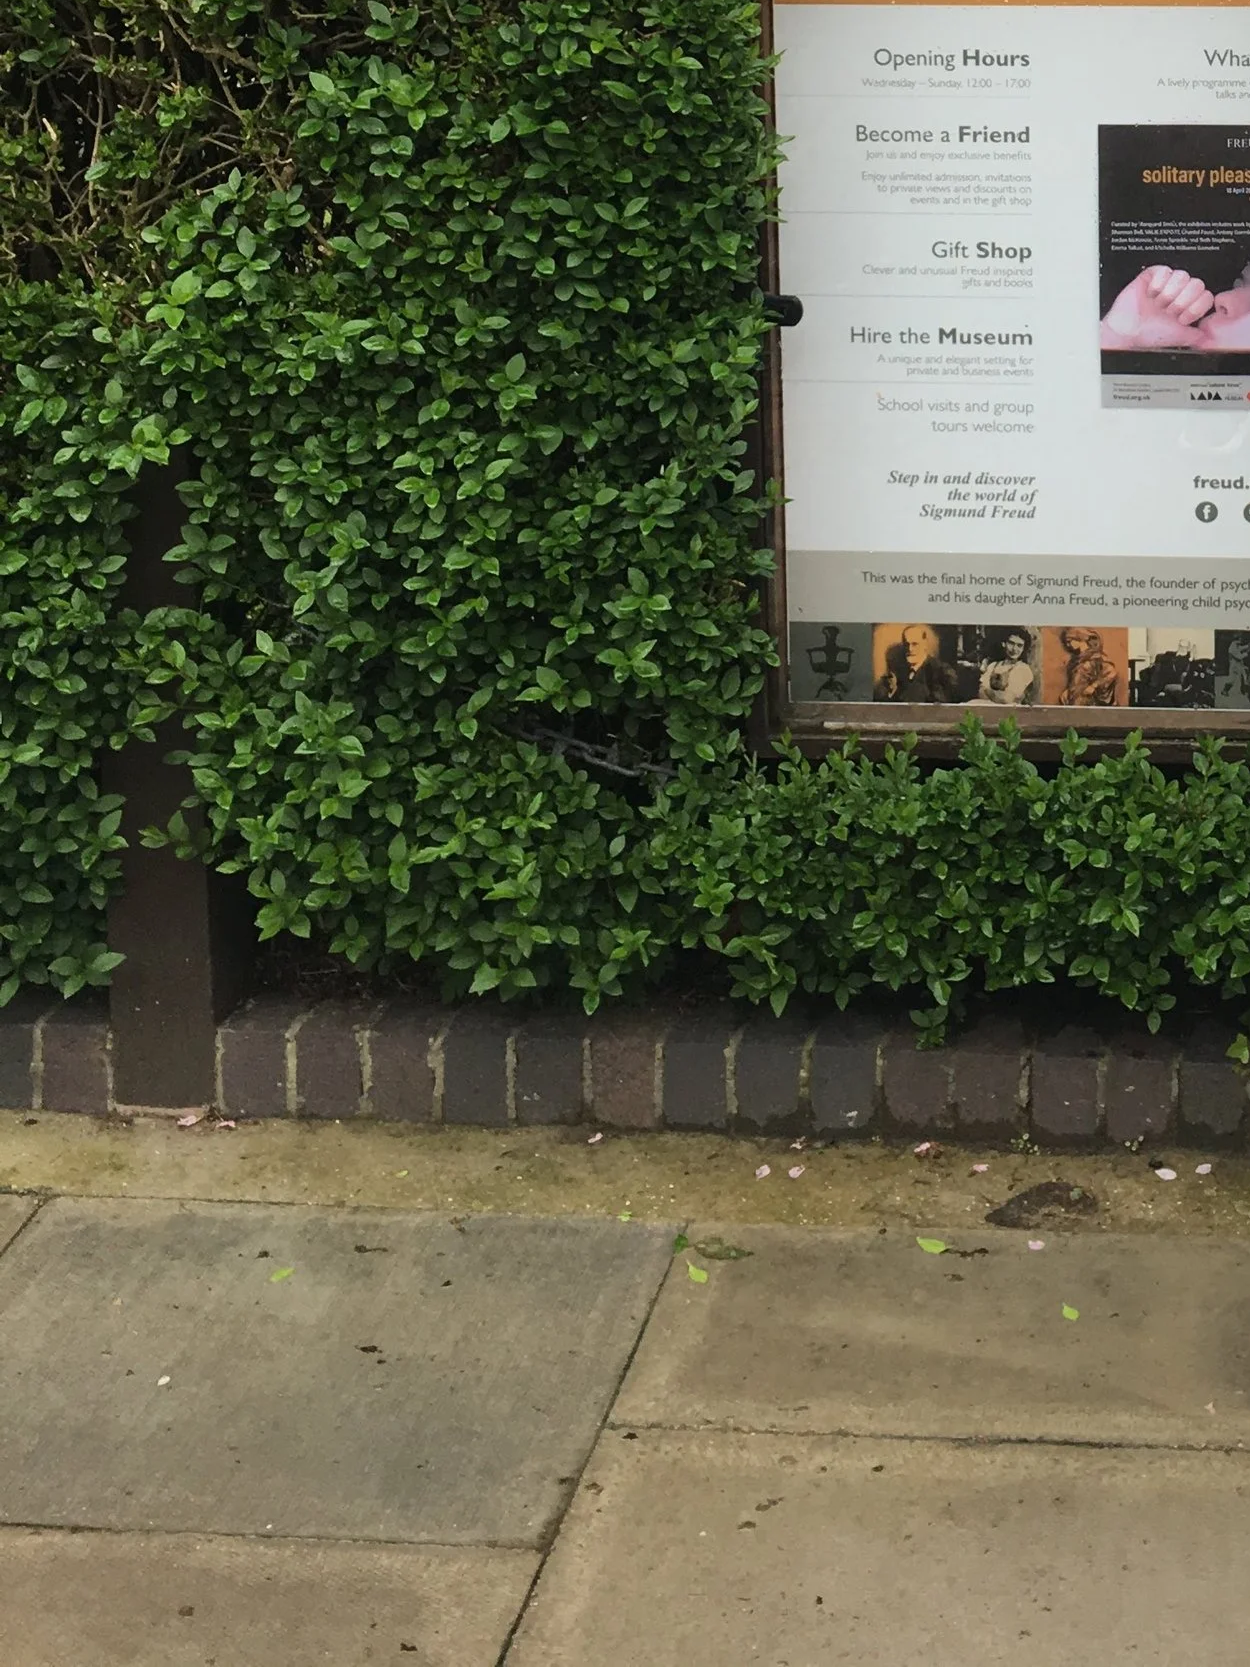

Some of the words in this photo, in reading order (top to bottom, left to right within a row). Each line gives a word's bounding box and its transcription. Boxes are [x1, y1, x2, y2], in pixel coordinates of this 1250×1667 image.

[874, 48, 954, 70] Opening
[962, 49, 1029, 66] Hours
[862, 78, 915, 90] Wednesday
[968, 79, 992, 87] 12:00
[1006, 79, 1031, 87] 17:00
[1158, 78, 1165, 86] A
[1168, 78, 1189, 87] lively
[1192, 80, 1246, 88] programme
[1216, 91, 1235, 99] talks
[856, 124, 932, 142] Become
[941, 131, 950, 142] a
[958, 125, 1029, 142] Friend
[866, 150, 883, 161] Join
[900, 150, 916, 159] and
[920, 151, 944, 161] enjoy
[948, 150, 990, 159] exclusive
[993, 150, 1031, 160] benefits
[862, 172, 887, 182] Enjoy
[889, 172, 932, 181] unlimited
[986, 173, 1031, 182] invitations
[1143, 166, 1204, 186] solitary
[878, 184, 887, 192] to
[890, 184, 922, 194] private
[973, 185, 1015, 193] discounts
[943, 196, 959, 204] and
[973, 196, 988, 204] the
[991, 196, 1007, 206] gift
[1009, 197, 1031, 206] shop
[932, 241, 968, 258] Gift
[976, 241, 1031, 262] Shop
[862, 265, 895, 274] Clever
[899, 265, 916, 275] and
[920, 265, 956, 275] unusual
[961, 266, 990, 275] Freud
[993, 266, 1033, 277] inspired
[850, 326, 891, 343] Hire
[899, 327, 929, 343] the
[939, 328, 1032, 345] Museum
[888, 357, 921, 366] unique
[925, 355, 942, 363] and
[946, 356, 980, 366] elegant
[984, 356, 1016, 367] setting
[1019, 356, 1033, 364] for
[877, 398, 922, 411] School
[928, 398, 959, 411] visits
[965, 399, 988, 412] and
[994, 403, 1033, 415] group
[932, 420, 967, 431] tours
[972, 420, 1033, 433] welcome
[887, 470, 919, 486] Step
[923, 471, 938, 483] in
[943, 471, 971, 484] and
[975, 472, 1035, 485] discover
[947, 488, 970, 501] the
[975, 489, 1016, 501] world
[1020, 489, 1037, 505] of
[919, 504, 986, 519] Sigmund
[991, 505, 1036, 518] Freud
[862, 571, 886, 583] This
[890, 575, 913, 583] was
[918, 573, 937, 584] the
[941, 572, 965, 584] final
[969, 573, 1004, 585] home
[1009, 574, 1022, 585] of
[1026, 574, 1078, 590] Sigmund
[1083, 575, 1121, 588] Freud,
[1126, 577, 1145, 588] the
[1150, 576, 1199, 589] founder
[1202, 577, 1216, 589] of
[928, 591, 950, 602] and
[954, 591, 970, 603] his
[974, 591, 1029, 607] daughter
[1032, 592, 1065, 604] Anna
[1069, 593, 1107, 606] Freud,
[1112, 597, 1119, 605] a
[1123, 595, 1188, 610] pioneering
[1192, 596, 1220, 607] child
